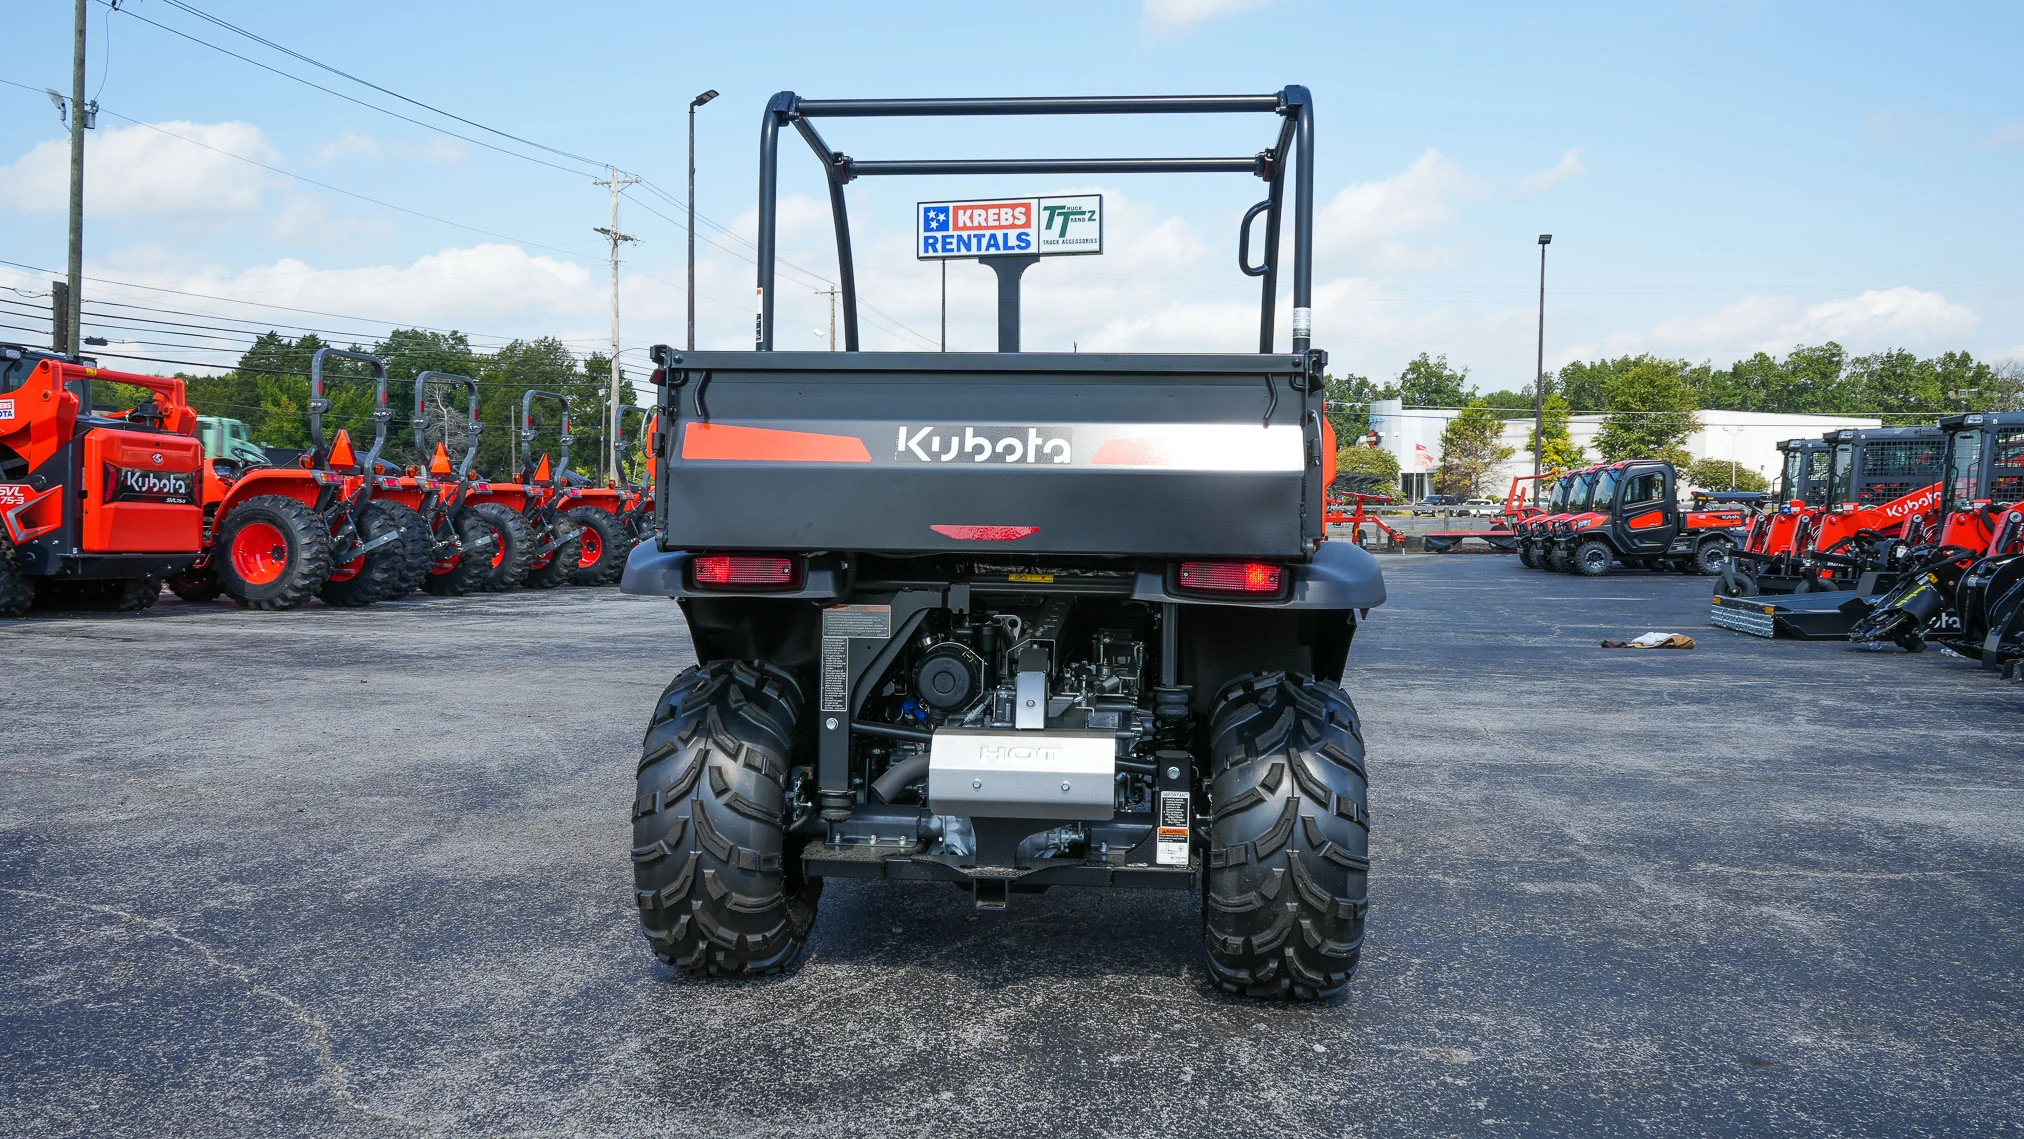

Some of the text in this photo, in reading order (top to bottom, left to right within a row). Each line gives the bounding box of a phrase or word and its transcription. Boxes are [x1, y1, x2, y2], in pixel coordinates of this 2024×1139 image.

[958, 207, 1027, 228] KREBS
[923, 231, 1031, 254] RENTALS
[1062, 237, 1098, 245] ACCESSORIES
[897, 426, 1072, 464] Kubota
[127, 471, 186, 493] Kubota
[979, 745, 1064, 761] HOT
